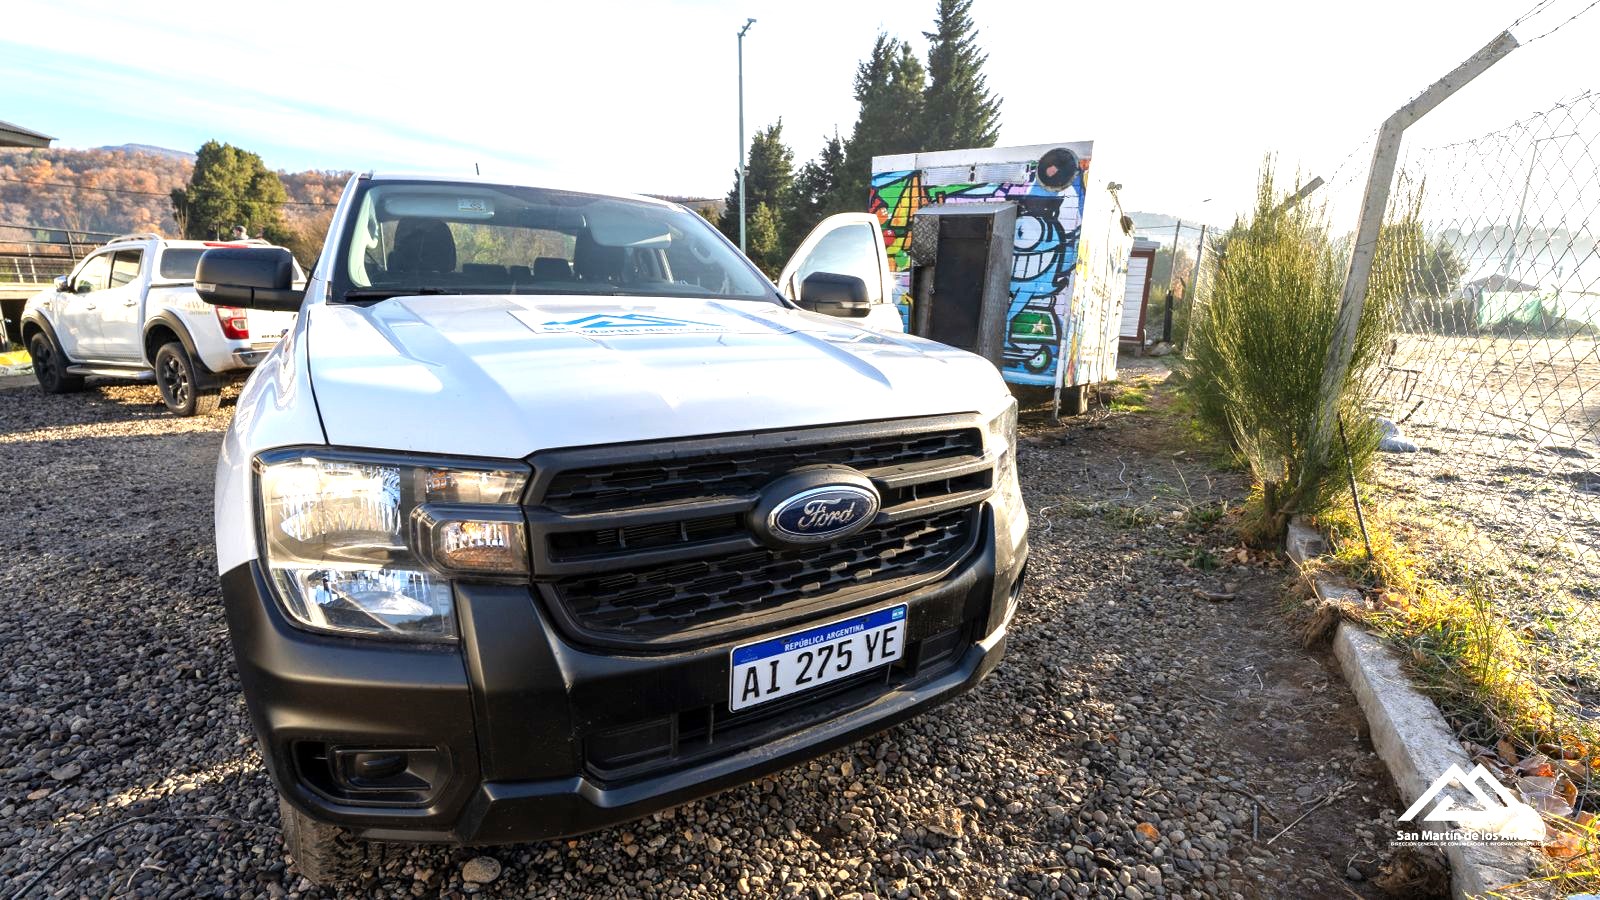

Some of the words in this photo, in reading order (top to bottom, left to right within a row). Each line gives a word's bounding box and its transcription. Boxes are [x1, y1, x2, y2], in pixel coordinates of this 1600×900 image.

[797, 497, 856, 529] Ford
[783, 635, 825, 652] REPÚBLICA
[825, 623, 865, 641] ARGENTINA
[741, 659, 781, 702] AI
[795, 638, 853, 686] 275
[865, 625, 898, 663] YE
